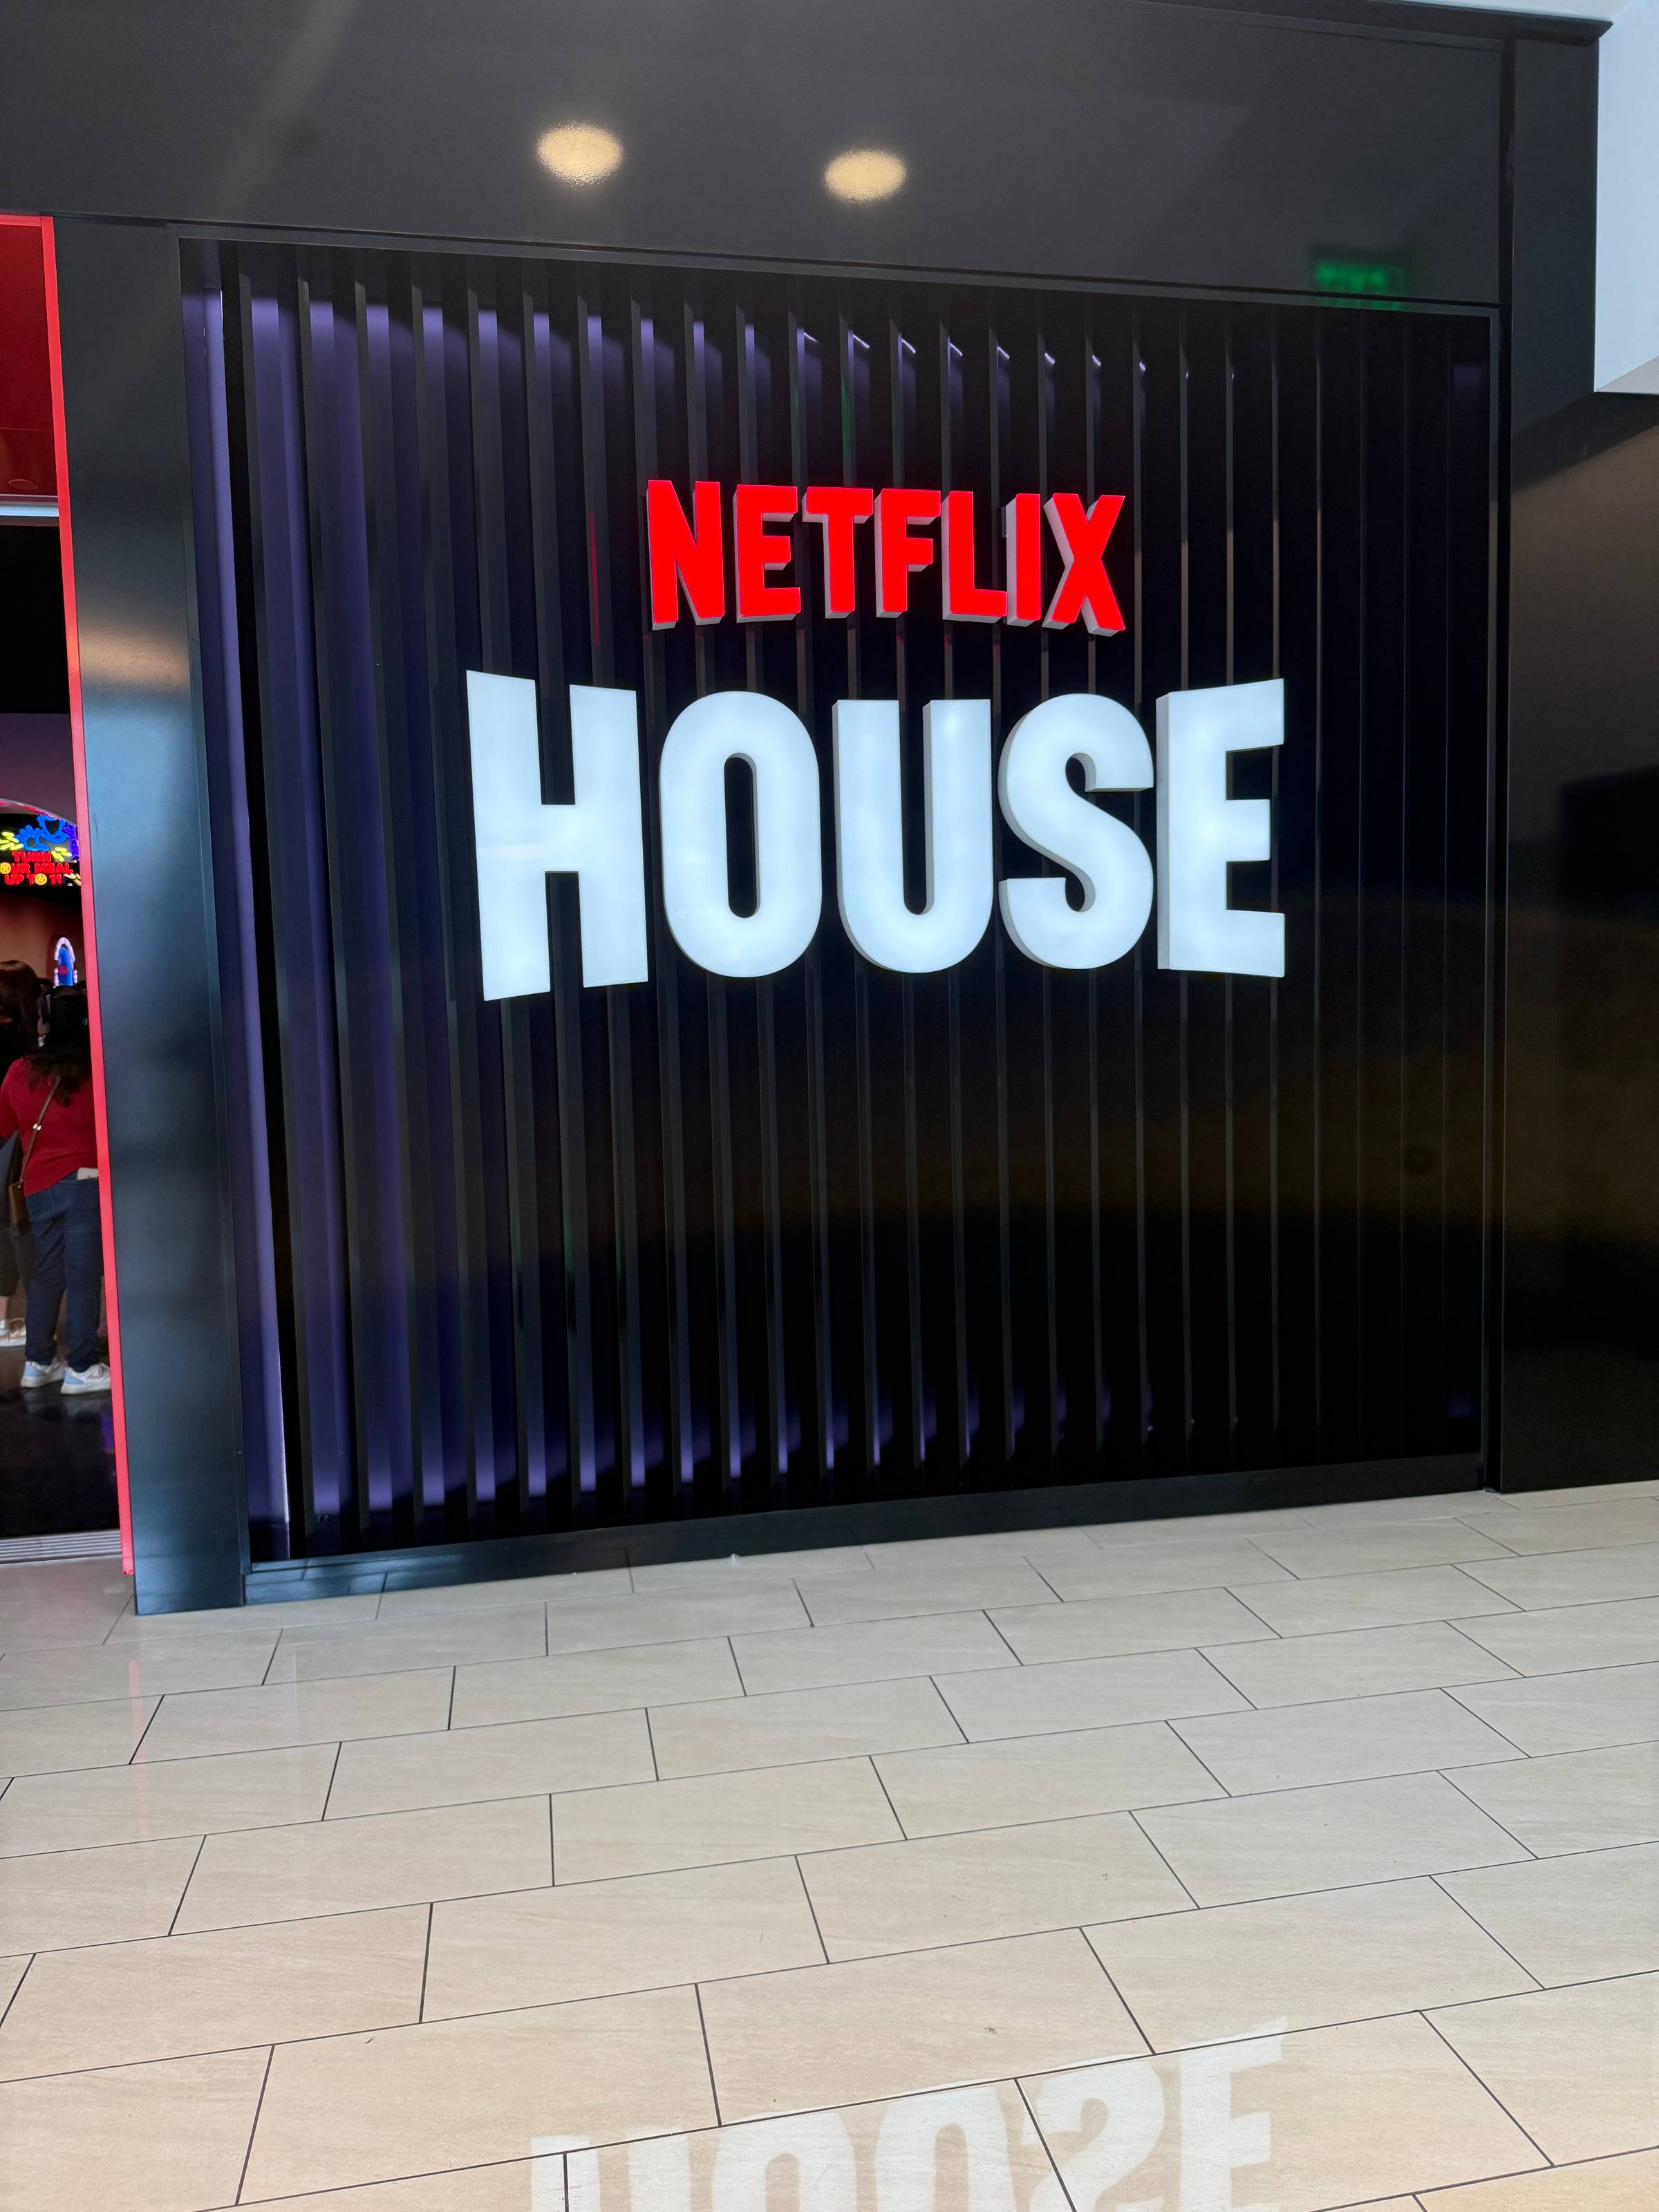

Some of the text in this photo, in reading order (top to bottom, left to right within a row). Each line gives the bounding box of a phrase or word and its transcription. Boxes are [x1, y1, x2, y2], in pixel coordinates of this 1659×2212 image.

[646, 479, 1126, 636] NETFLIX
[466, 670, 1284, 1002] HOUSE
[11, 851, 52, 863] TURN
[34, 863, 73, 874] MEAL
[4, 873, 62, 885] UP TO 11
